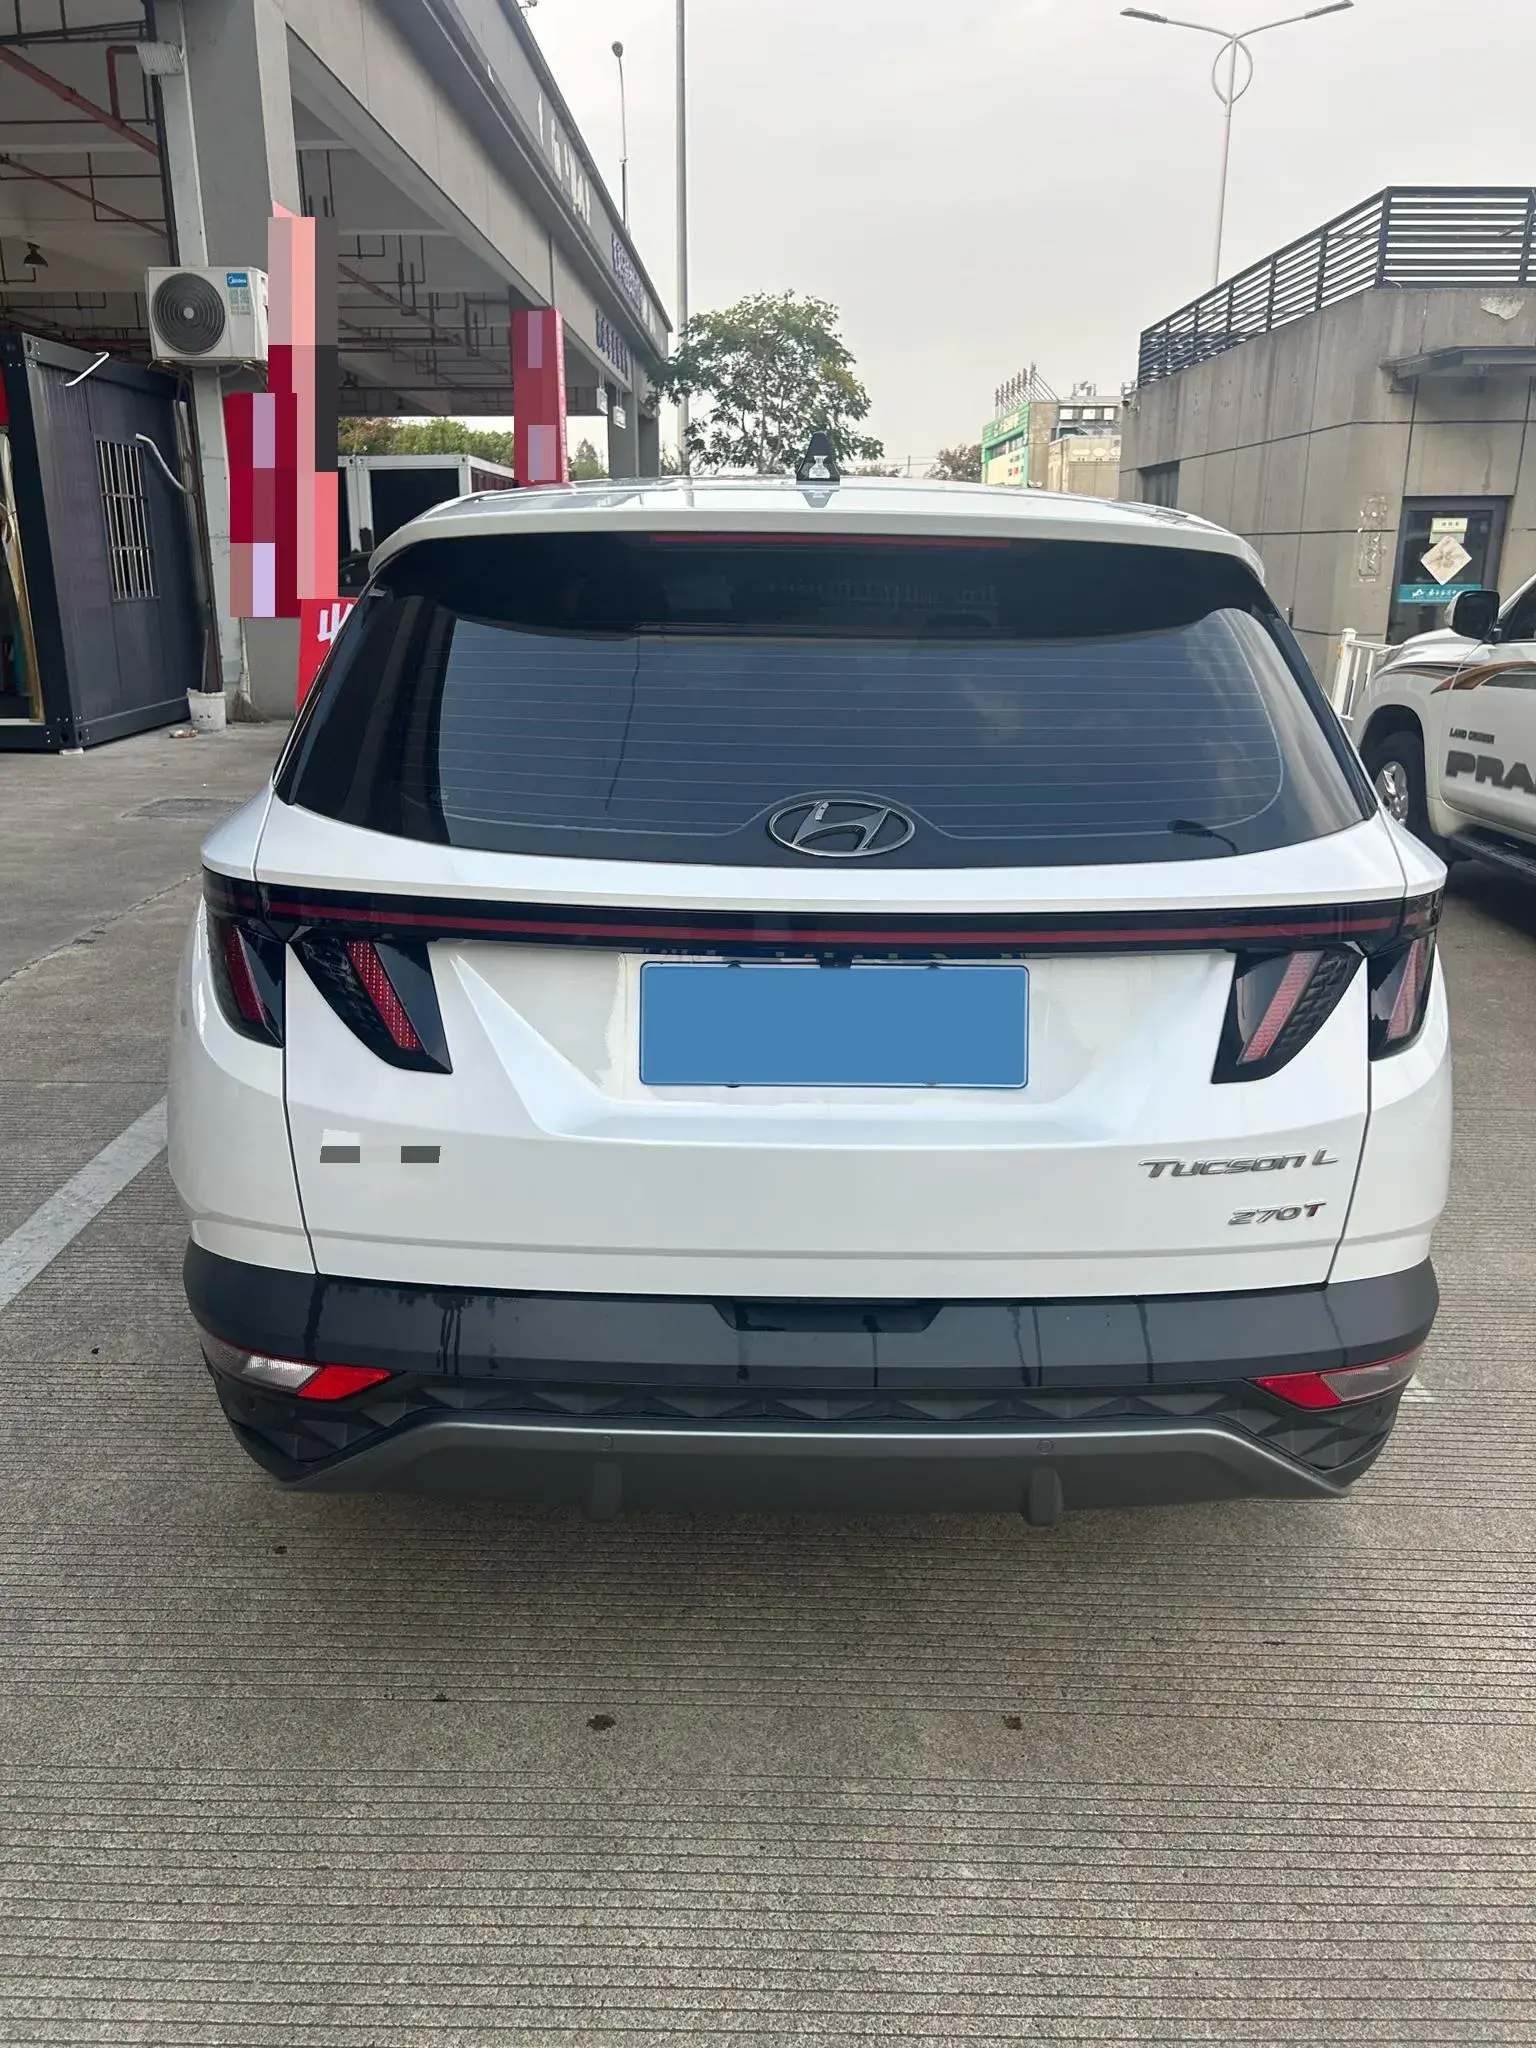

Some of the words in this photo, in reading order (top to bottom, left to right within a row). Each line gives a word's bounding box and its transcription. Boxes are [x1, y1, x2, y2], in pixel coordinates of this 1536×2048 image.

[1449, 727, 1467, 740] LAND
[1445, 749, 1536, 796] PRA
[1311, 1147, 1339, 1166] L
[1228, 1200, 1327, 1225] 270T
